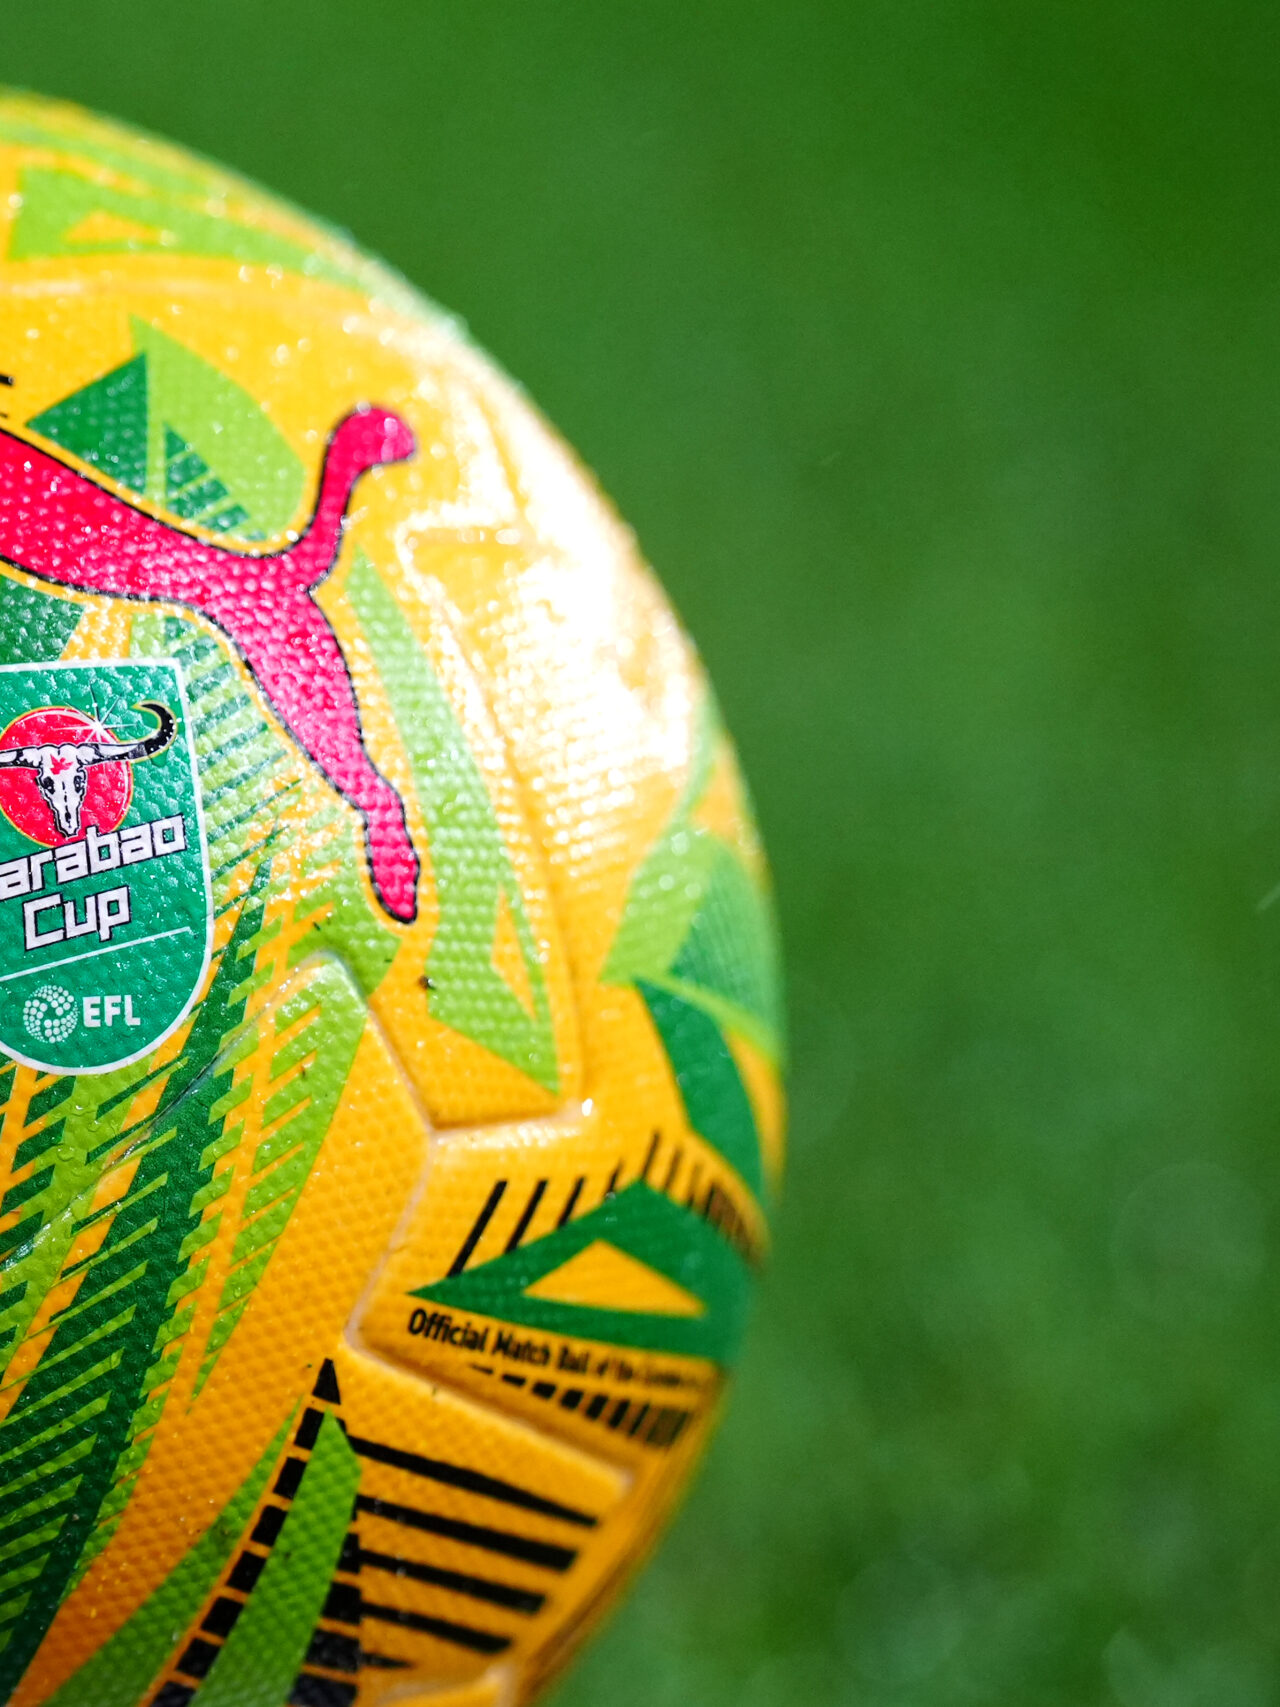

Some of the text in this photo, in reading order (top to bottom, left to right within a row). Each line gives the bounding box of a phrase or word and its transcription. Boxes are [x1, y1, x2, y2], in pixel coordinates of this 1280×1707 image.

[22, 886, 132, 952] Cup
[82, 995, 141, 1027] EFL
[408, 1308, 489, 1352] Official
[491, 1330, 551, 1367] Match
